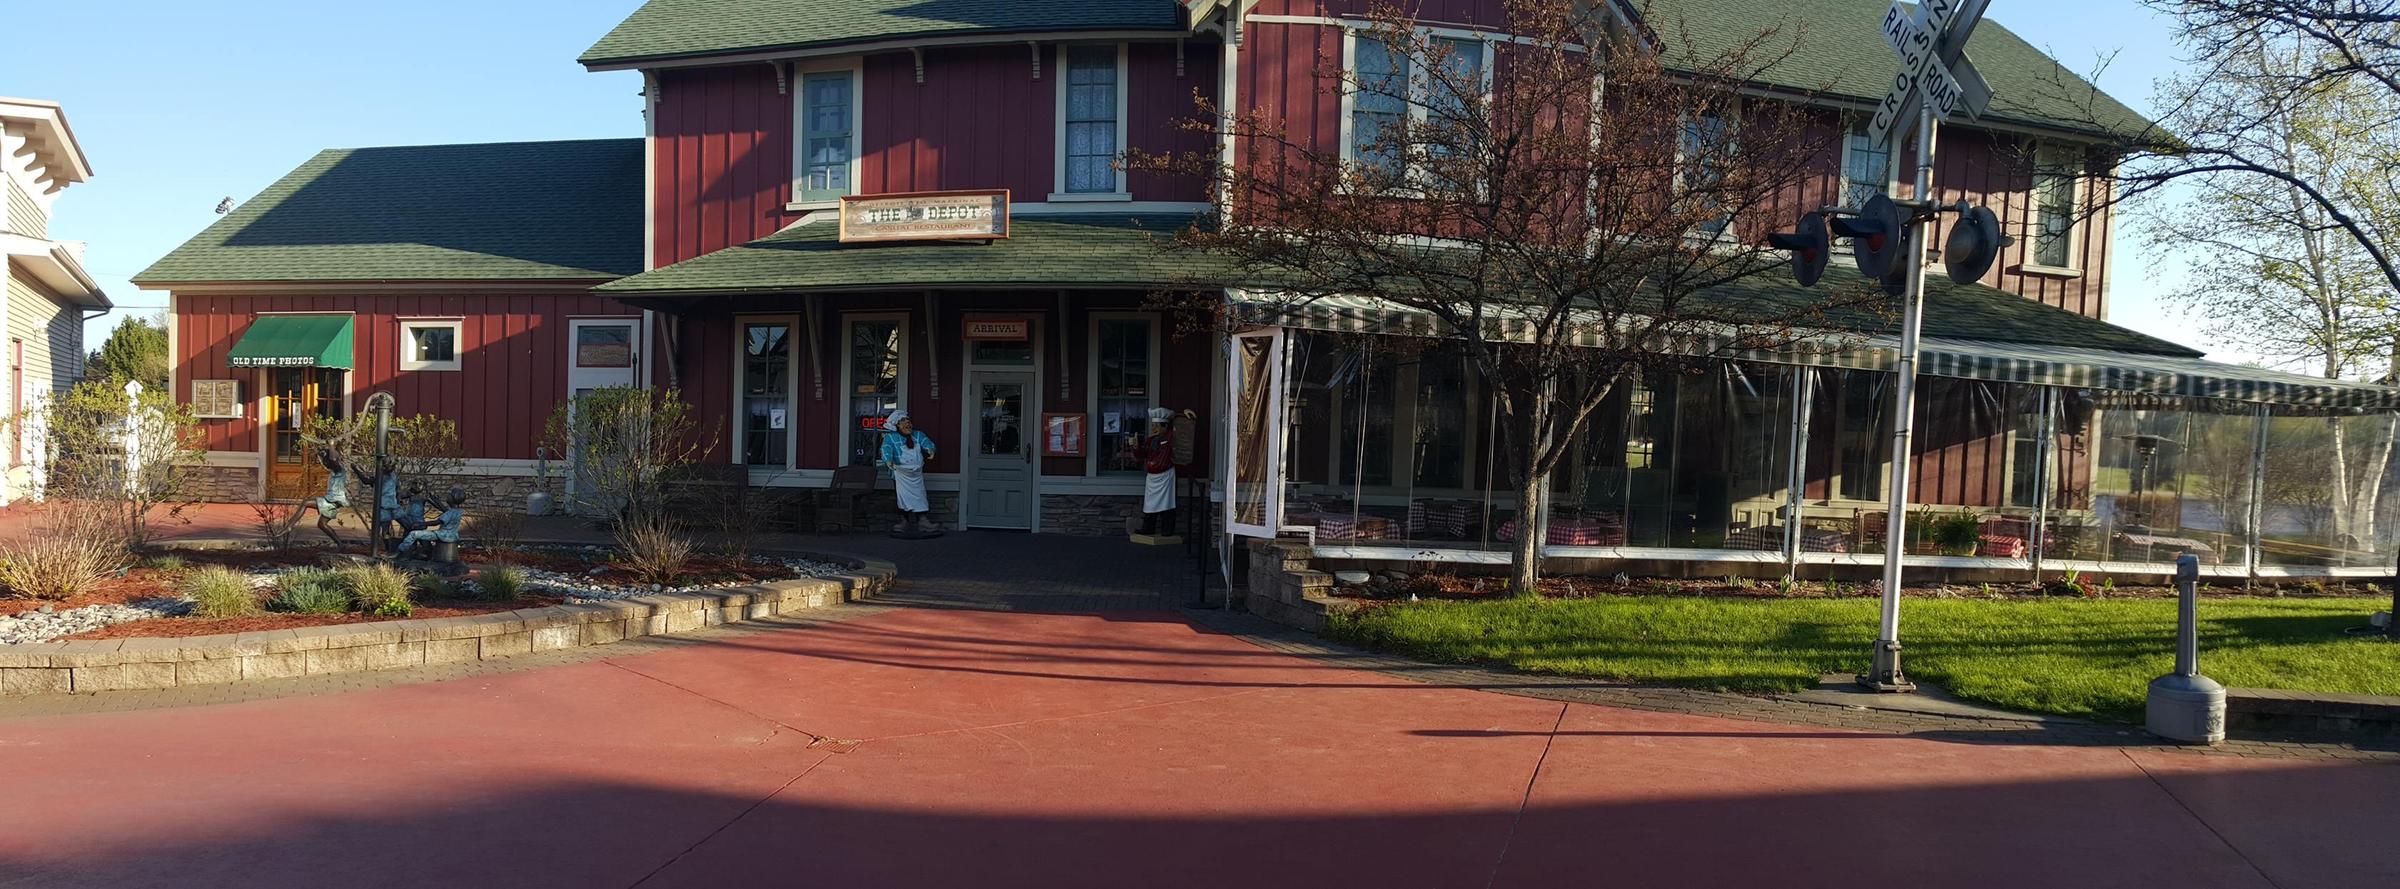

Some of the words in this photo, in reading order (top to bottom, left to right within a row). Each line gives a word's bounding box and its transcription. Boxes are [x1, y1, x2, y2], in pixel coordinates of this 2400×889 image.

[1876, 0, 1949, 131] CROSSIN
[1883, 6, 1911, 56] RAIL
[1922, 63, 1956, 114] ROAD
[869, 208, 900, 222] THE
[928, 205, 980, 220] DEPOT
[973, 324, 1018, 333] ARRIVAL
[233, 357, 250, 365] OLD
[252, 357, 276, 365] TIME
[279, 356, 314, 365] PHOTOS
